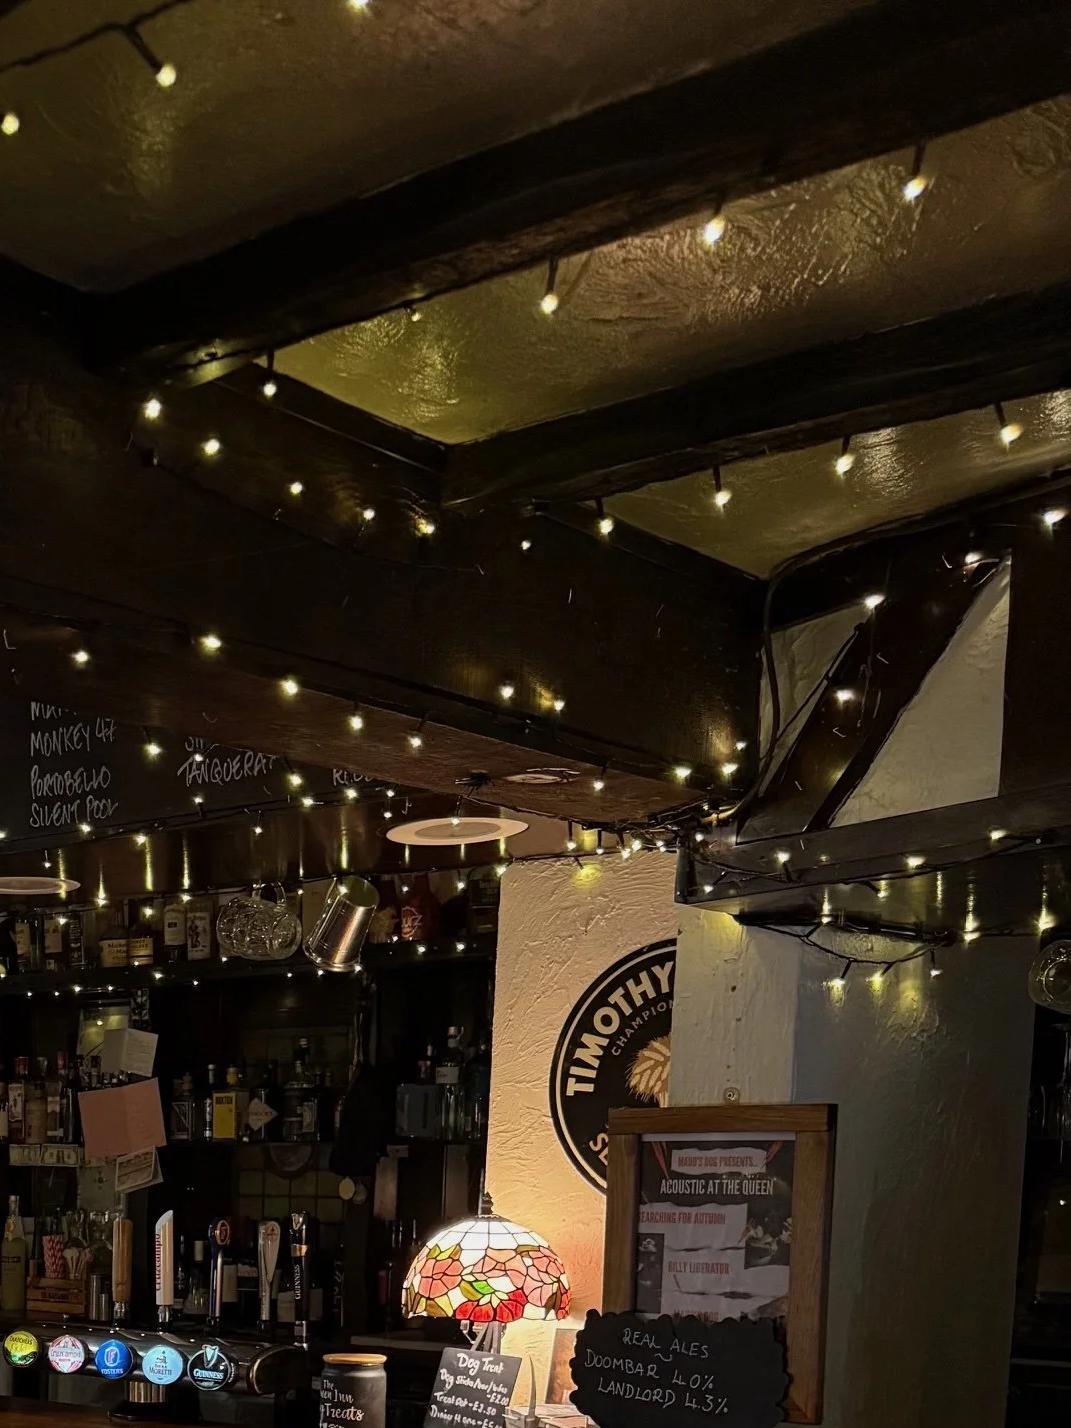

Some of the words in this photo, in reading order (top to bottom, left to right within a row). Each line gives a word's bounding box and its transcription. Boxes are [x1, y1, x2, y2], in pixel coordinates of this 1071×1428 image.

[30, 722, 90, 758] MONKEY
[95, 716, 118, 742] 47
[30, 764, 111, 800] PORTOBELLO
[29, 799, 81, 828] SILENT
[85, 794, 119, 822] POOL
[565, 960, 675, 1098] TIMOTHY
[660, 1178, 706, 1195] ACOUSTIC
[707, 1179, 721, 1195] AT
[722, 1179, 742, 1195] THE
[742, 1179, 774, 1196] QUEEN
[678, 1212, 692, 1225] FOR
[693, 1212, 726, 1225] AUTUMN
[293, 1264, 302, 1300] GUINNESS
[622, 1327, 662, 1349] REAL
[669, 1338, 710, 1359] ALES
[149, 1367, 173, 1376] MORETTI
[192, 1367, 225, 1379] GUINNESS
[456, 1352, 481, 1376] Dog
[584, 1348, 660, 1380] DOOMBAR
[323, 1379, 335, 1391] The
[439, 1368, 455, 1391] Dog
[333, 1389, 354, 1404] Inn
[433, 1391, 455, 1404] Treat
[597, 1376, 677, 1409] LANDLORD
[684, 1392, 729, 1415] 4.3%
[324, 1402, 365, 1422] Treats
